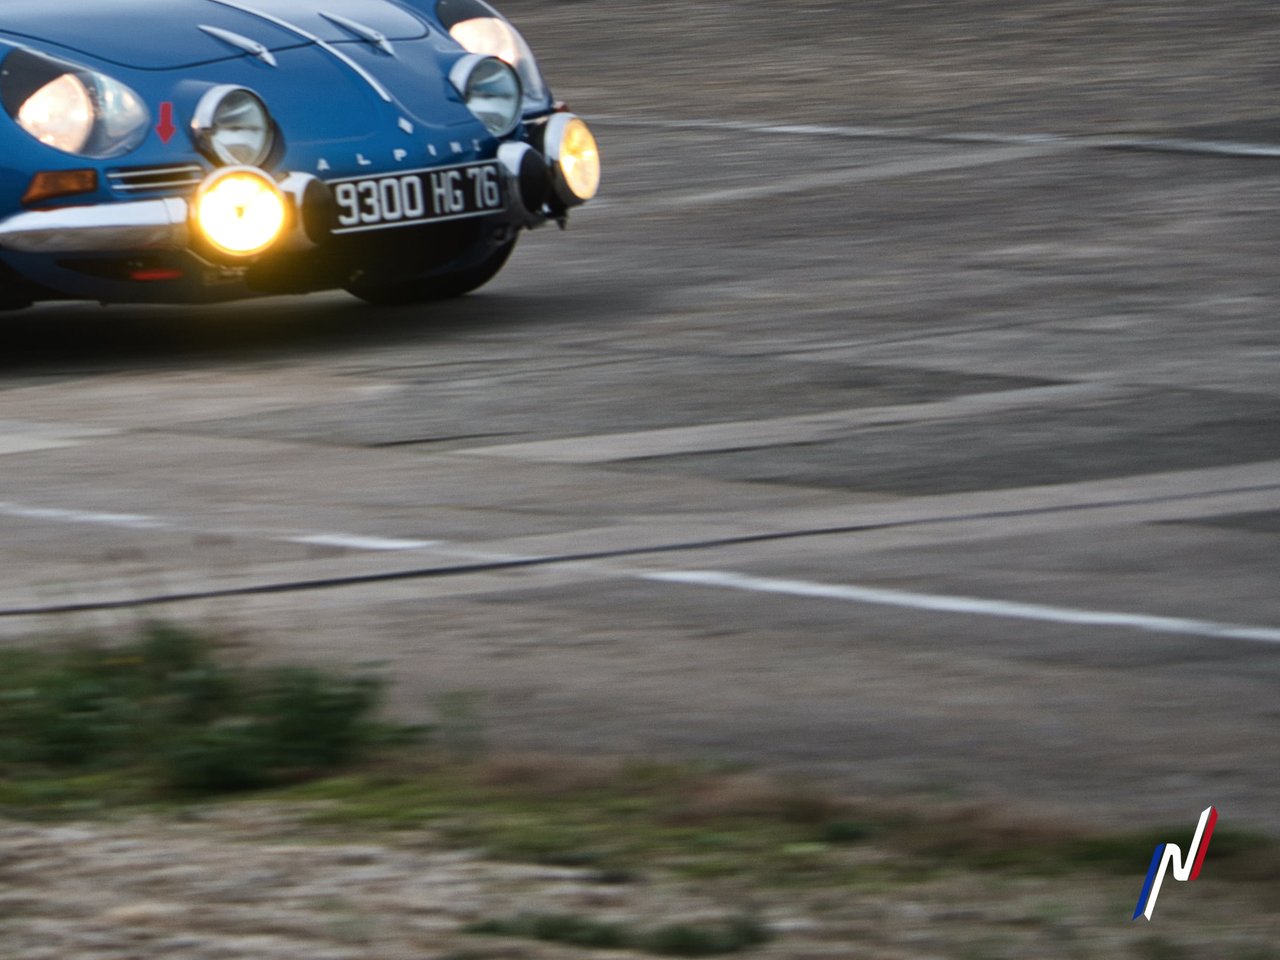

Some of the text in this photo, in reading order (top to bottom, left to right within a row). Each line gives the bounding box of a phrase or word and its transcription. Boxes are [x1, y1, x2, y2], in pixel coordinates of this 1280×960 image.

[335, 165, 500, 226] 9300 HG 76
